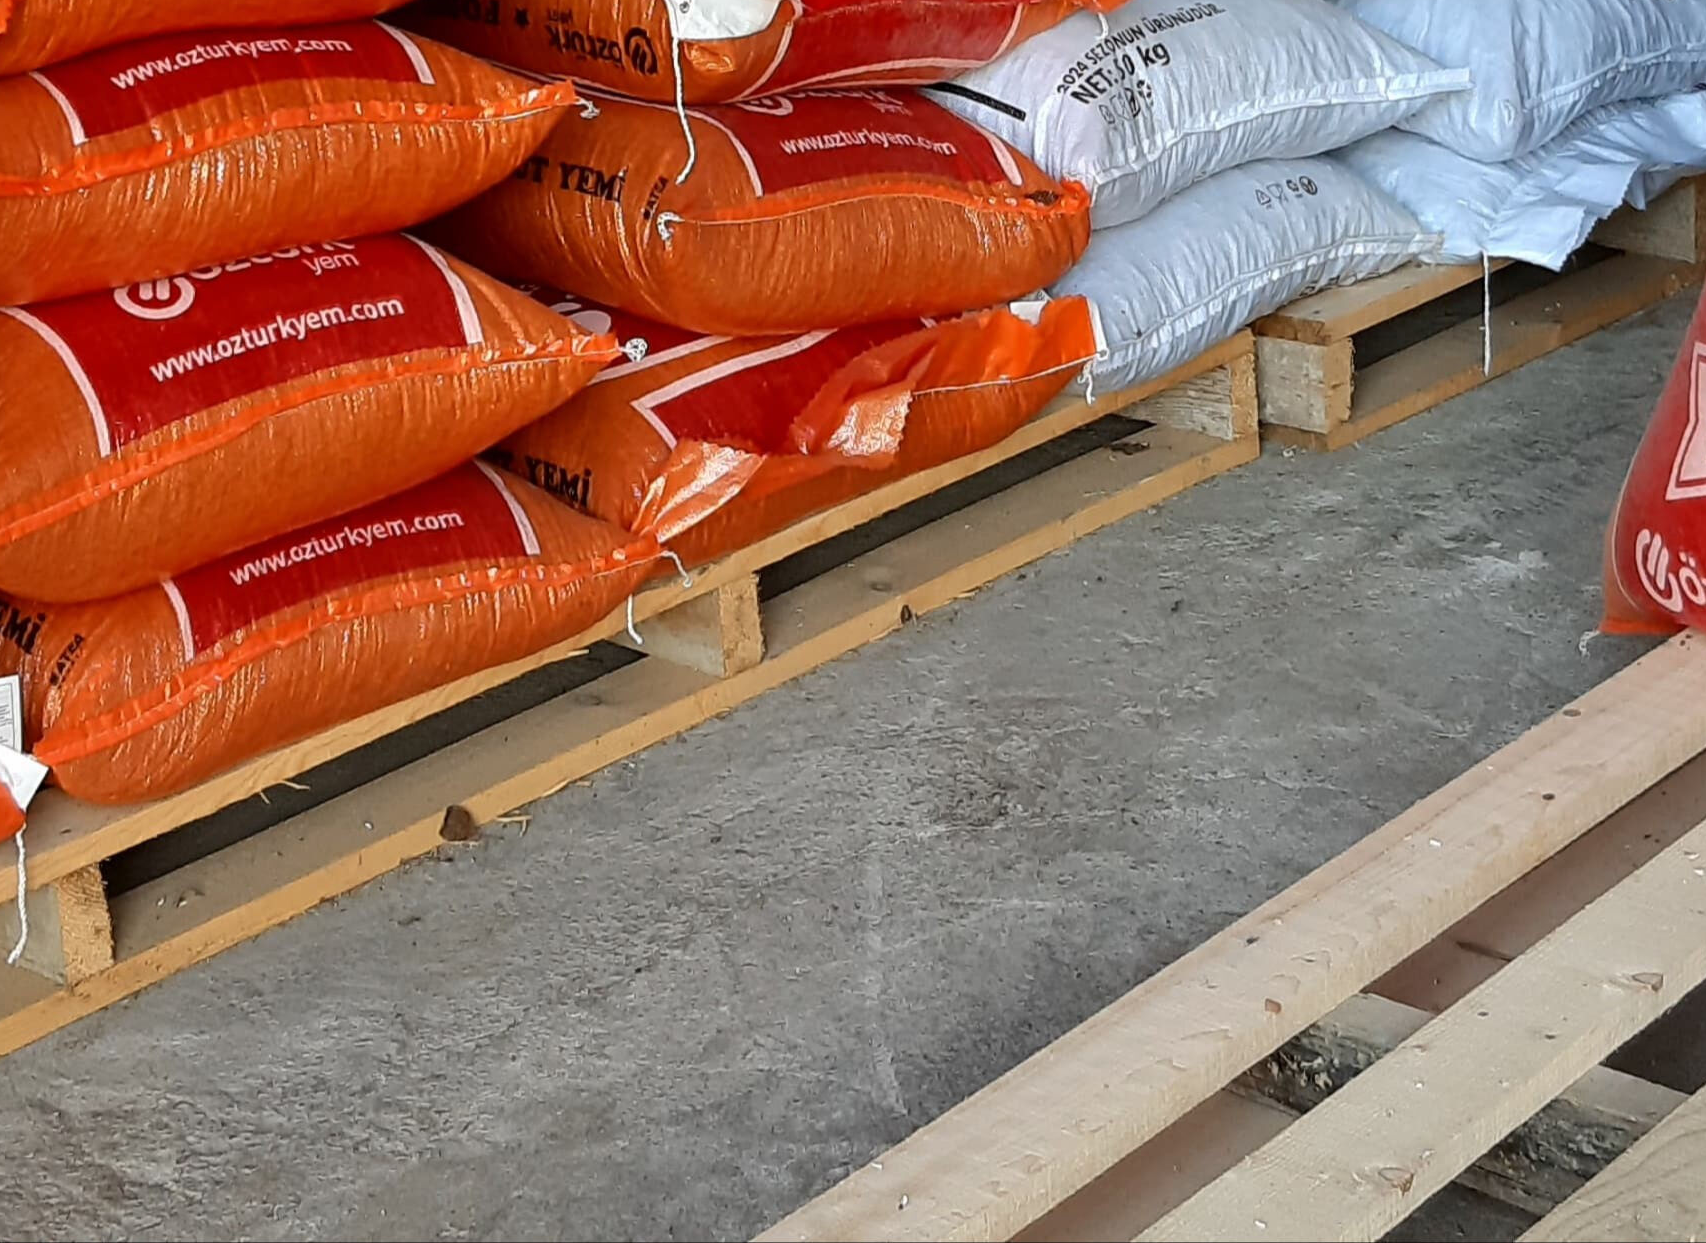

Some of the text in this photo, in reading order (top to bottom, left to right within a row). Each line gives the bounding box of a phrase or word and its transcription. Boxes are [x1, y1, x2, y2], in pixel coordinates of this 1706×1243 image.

[110, 33, 353, 93] www.ozturkyem.com
[1057, 60, 1090, 94] 2024
[1084, 23, 1146, 66] SEZONUN
[1136, 42, 1171, 68] kg
[558, 162, 628, 204] YEMİ
[301, 251, 361, 277] yem
[149, 294, 404, 384] www.ozturkyem.com
[228, 507, 465, 587] www.ozturkyem.com
